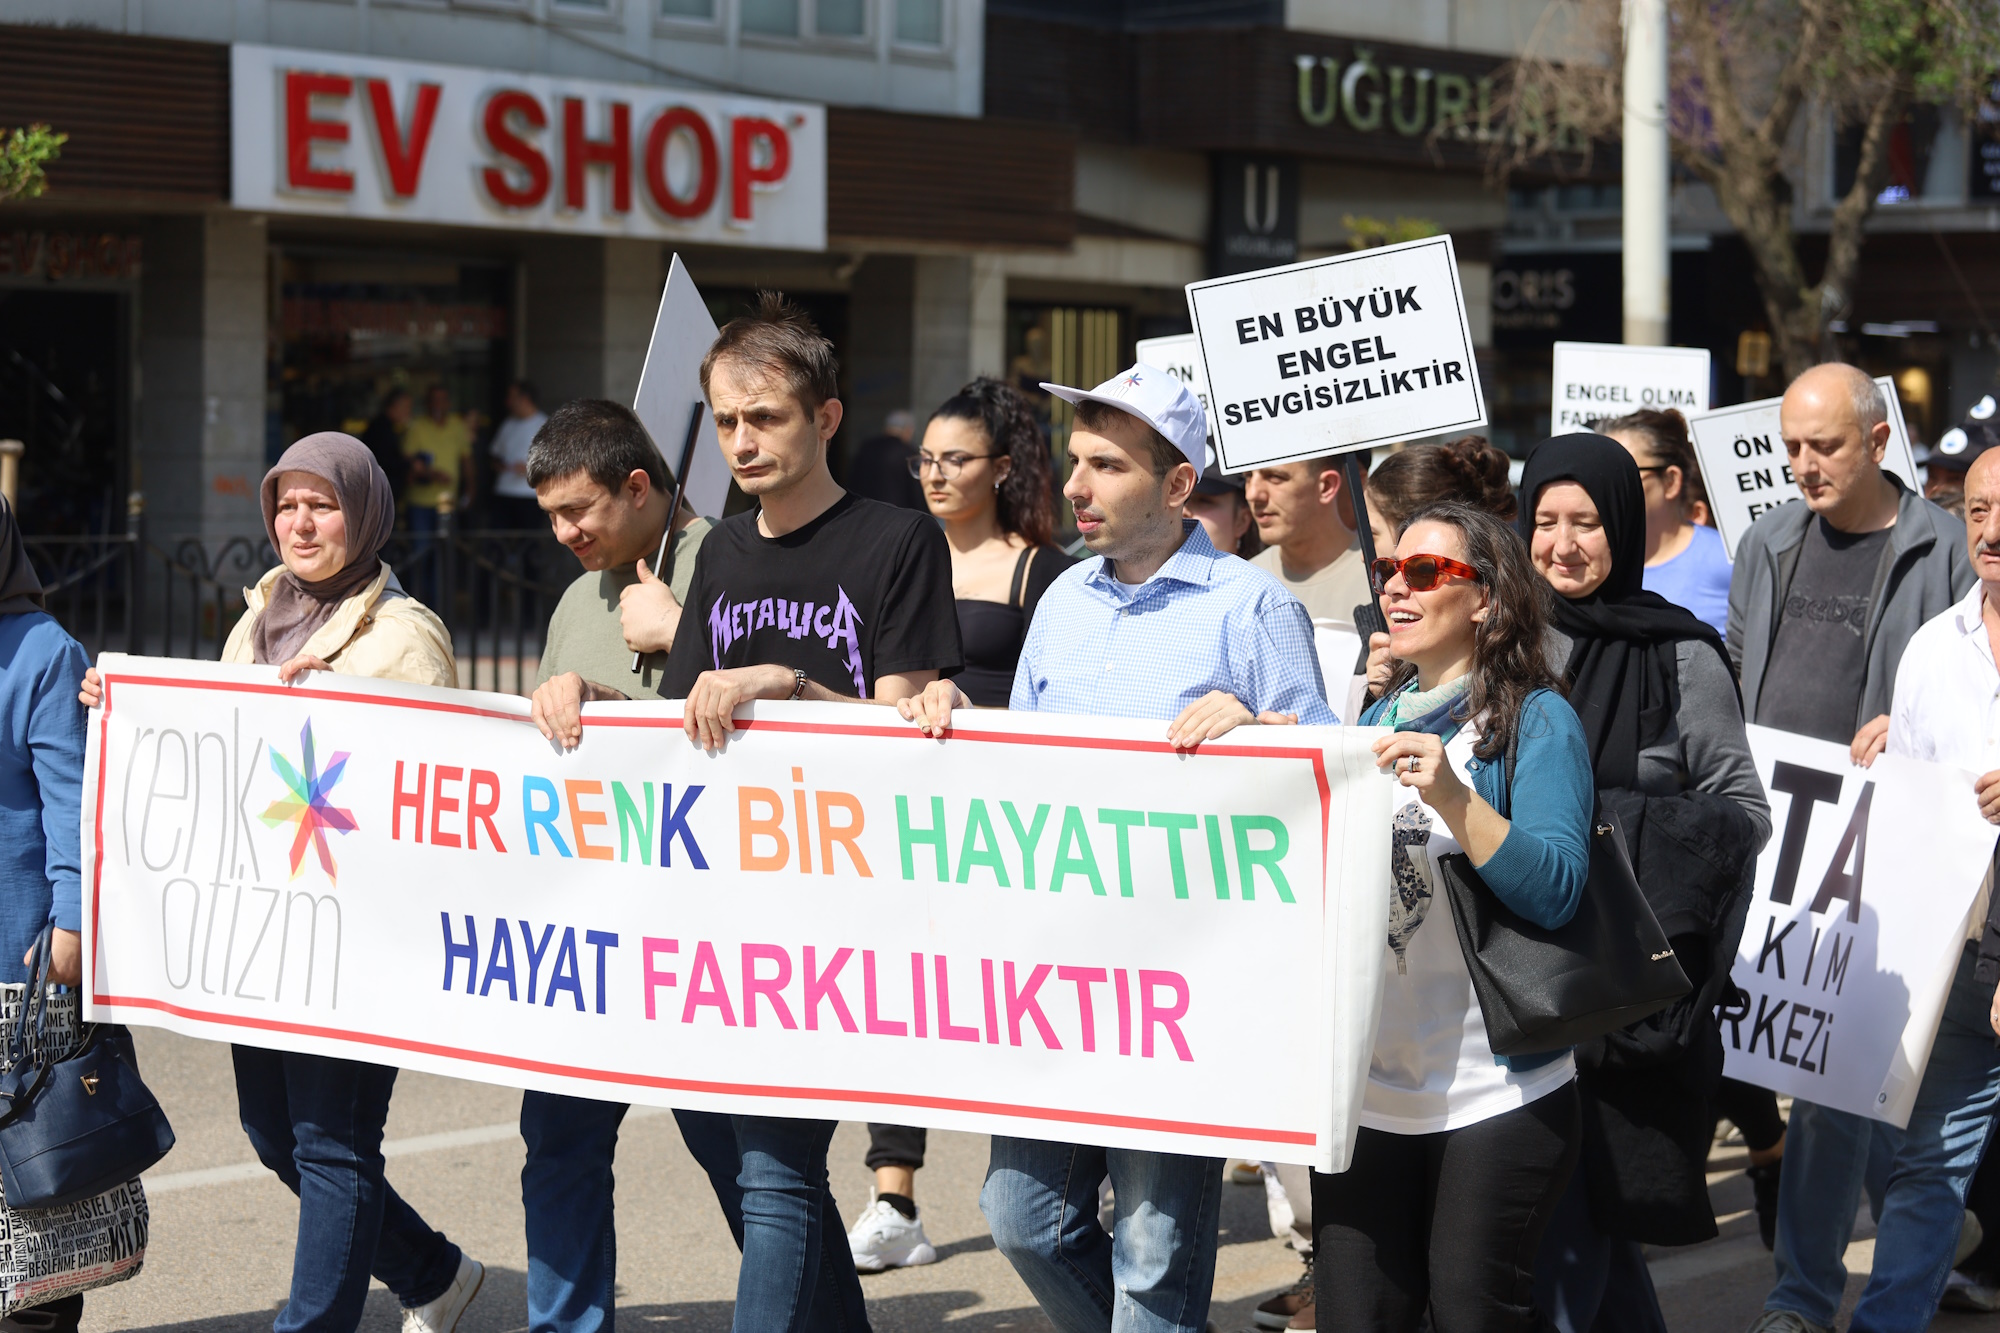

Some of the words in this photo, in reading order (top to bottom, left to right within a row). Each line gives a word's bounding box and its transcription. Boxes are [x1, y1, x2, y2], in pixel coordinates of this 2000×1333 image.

[280, 70, 442, 200] EV
[480, 88, 794, 226] SHOP
[1236, 312, 1284, 345] EN
[1294, 285, 1423, 334] BÜYÜK
[1277, 335, 1397, 380] ENGEL
[1224, 359, 1465, 426] SEVGİSİZLİKTİR
[1566, 384, 1633, 403] ENGEL
[1641, 388, 1697, 405] OLMA
[1733, 434, 1773, 459] ÖN
[1736, 469, 1774, 493] EN
[707, 584, 867, 699] METALLICA
[122, 706, 264, 882] renk
[391, 760, 508, 853] HER
[522, 775, 710, 870] RENK
[737, 767, 874, 878] BİR
[894, 795, 1297, 904] HAYATTIR
[162, 864, 342, 1010] otizm
[440, 911, 619, 1015] HAYAT
[642, 936, 1195, 1062] FARKLILIKTIR
